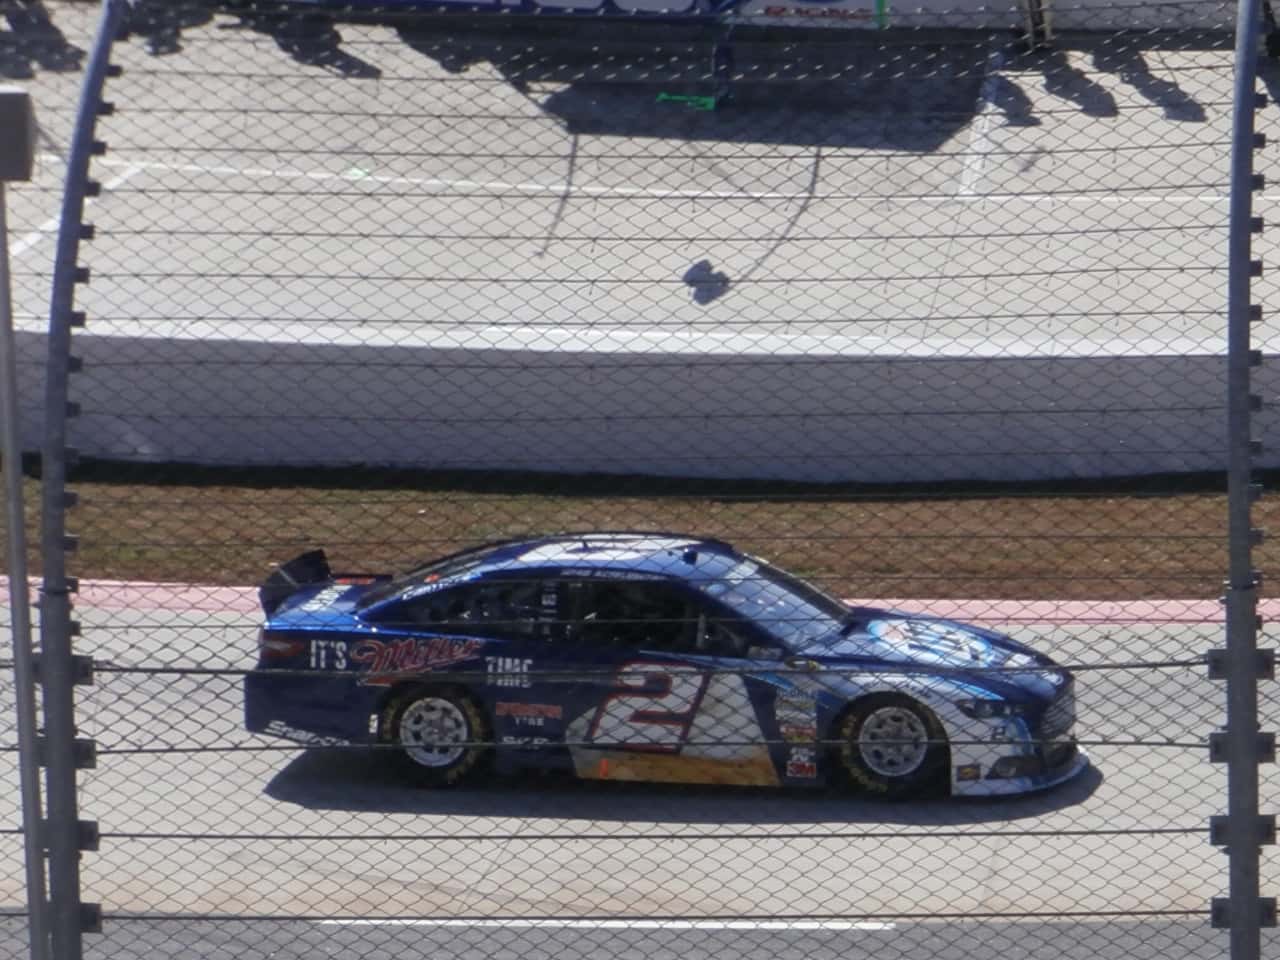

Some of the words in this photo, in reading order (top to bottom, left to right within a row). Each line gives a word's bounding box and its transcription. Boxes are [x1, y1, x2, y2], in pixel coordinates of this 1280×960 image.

[309, 639, 348, 670] IT'S
[351, 637, 484, 676] Miller
[484, 655, 534, 688] TIME
[588, 660, 703, 754] 2
